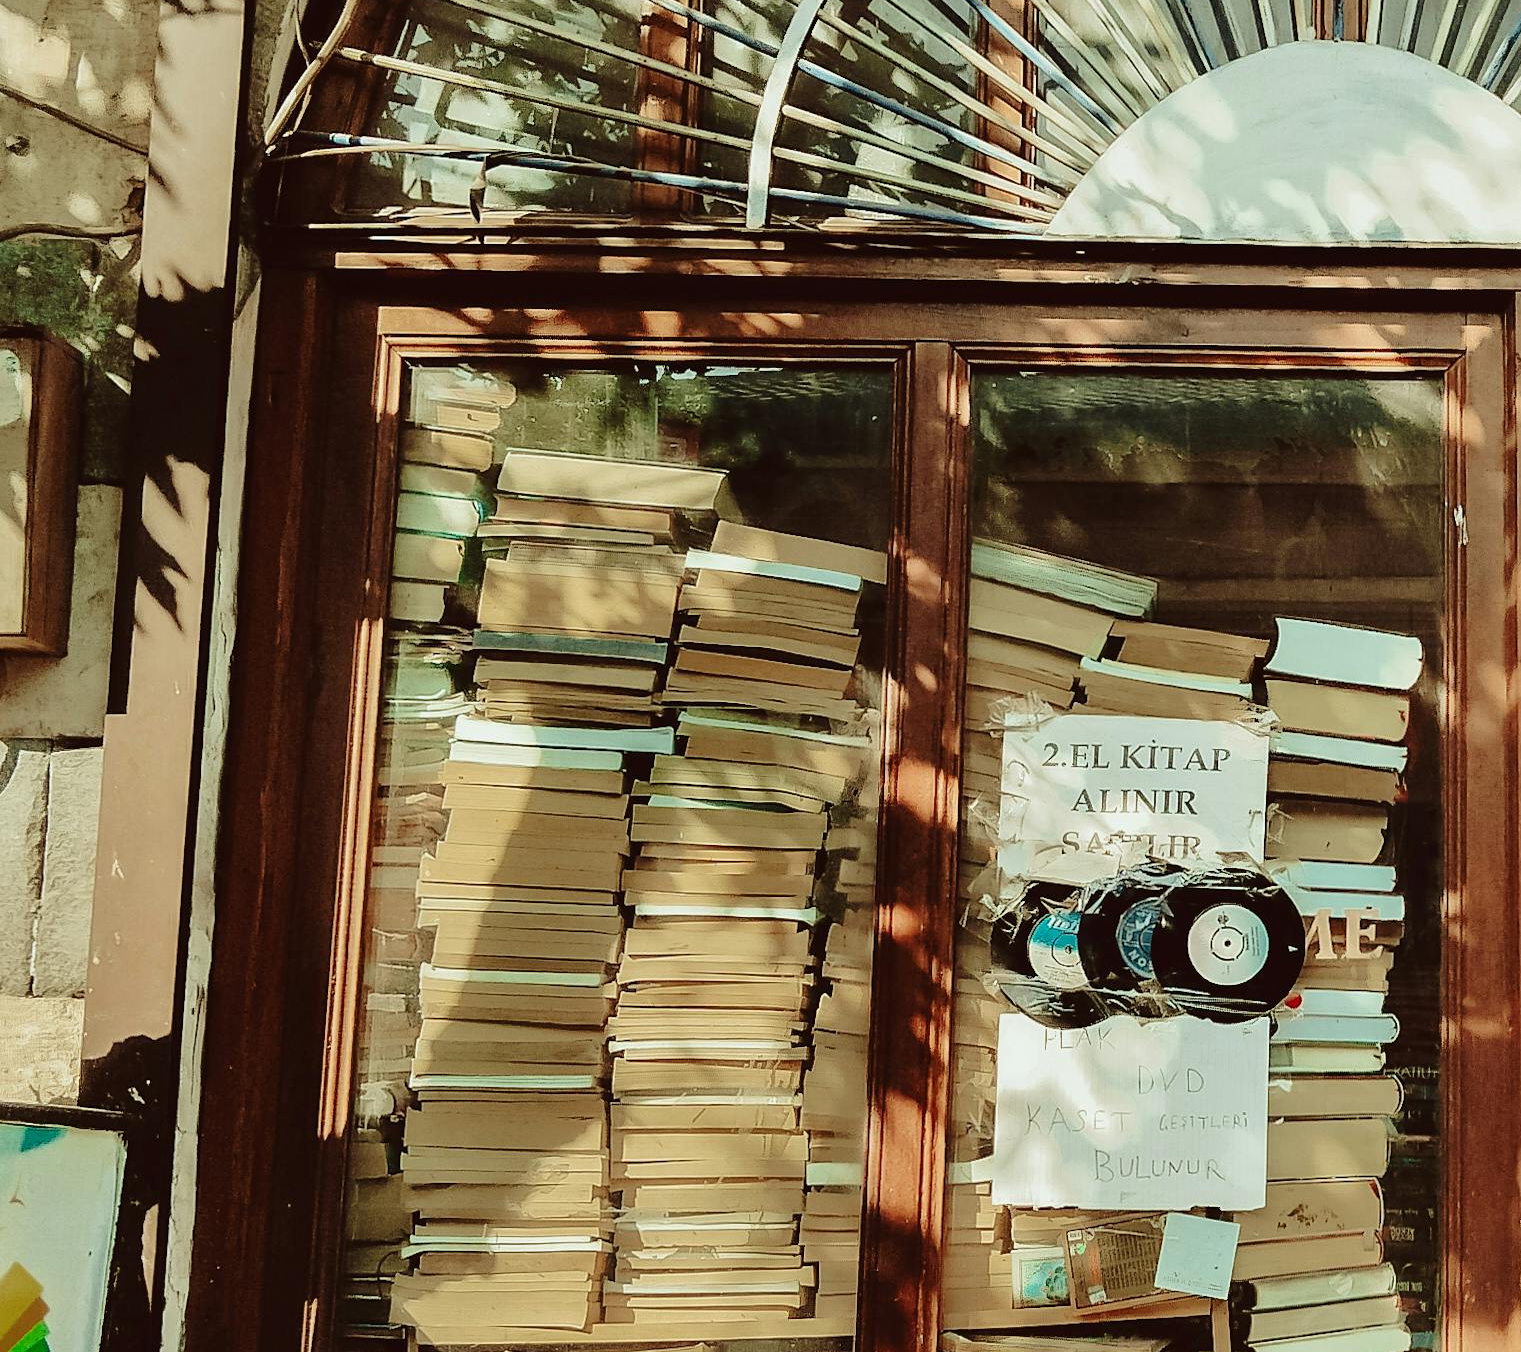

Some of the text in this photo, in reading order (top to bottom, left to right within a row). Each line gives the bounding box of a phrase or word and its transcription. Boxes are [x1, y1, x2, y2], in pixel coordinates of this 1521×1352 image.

[1042, 739, 1231, 771] 2.EL KİTAP
[1071, 789, 1199, 815] ALINIR
[1138, 1064, 1205, 1095] DVD
[1024, 1103, 1132, 1135] KASET
[1095, 1149, 1226, 1183] BULUNUR
